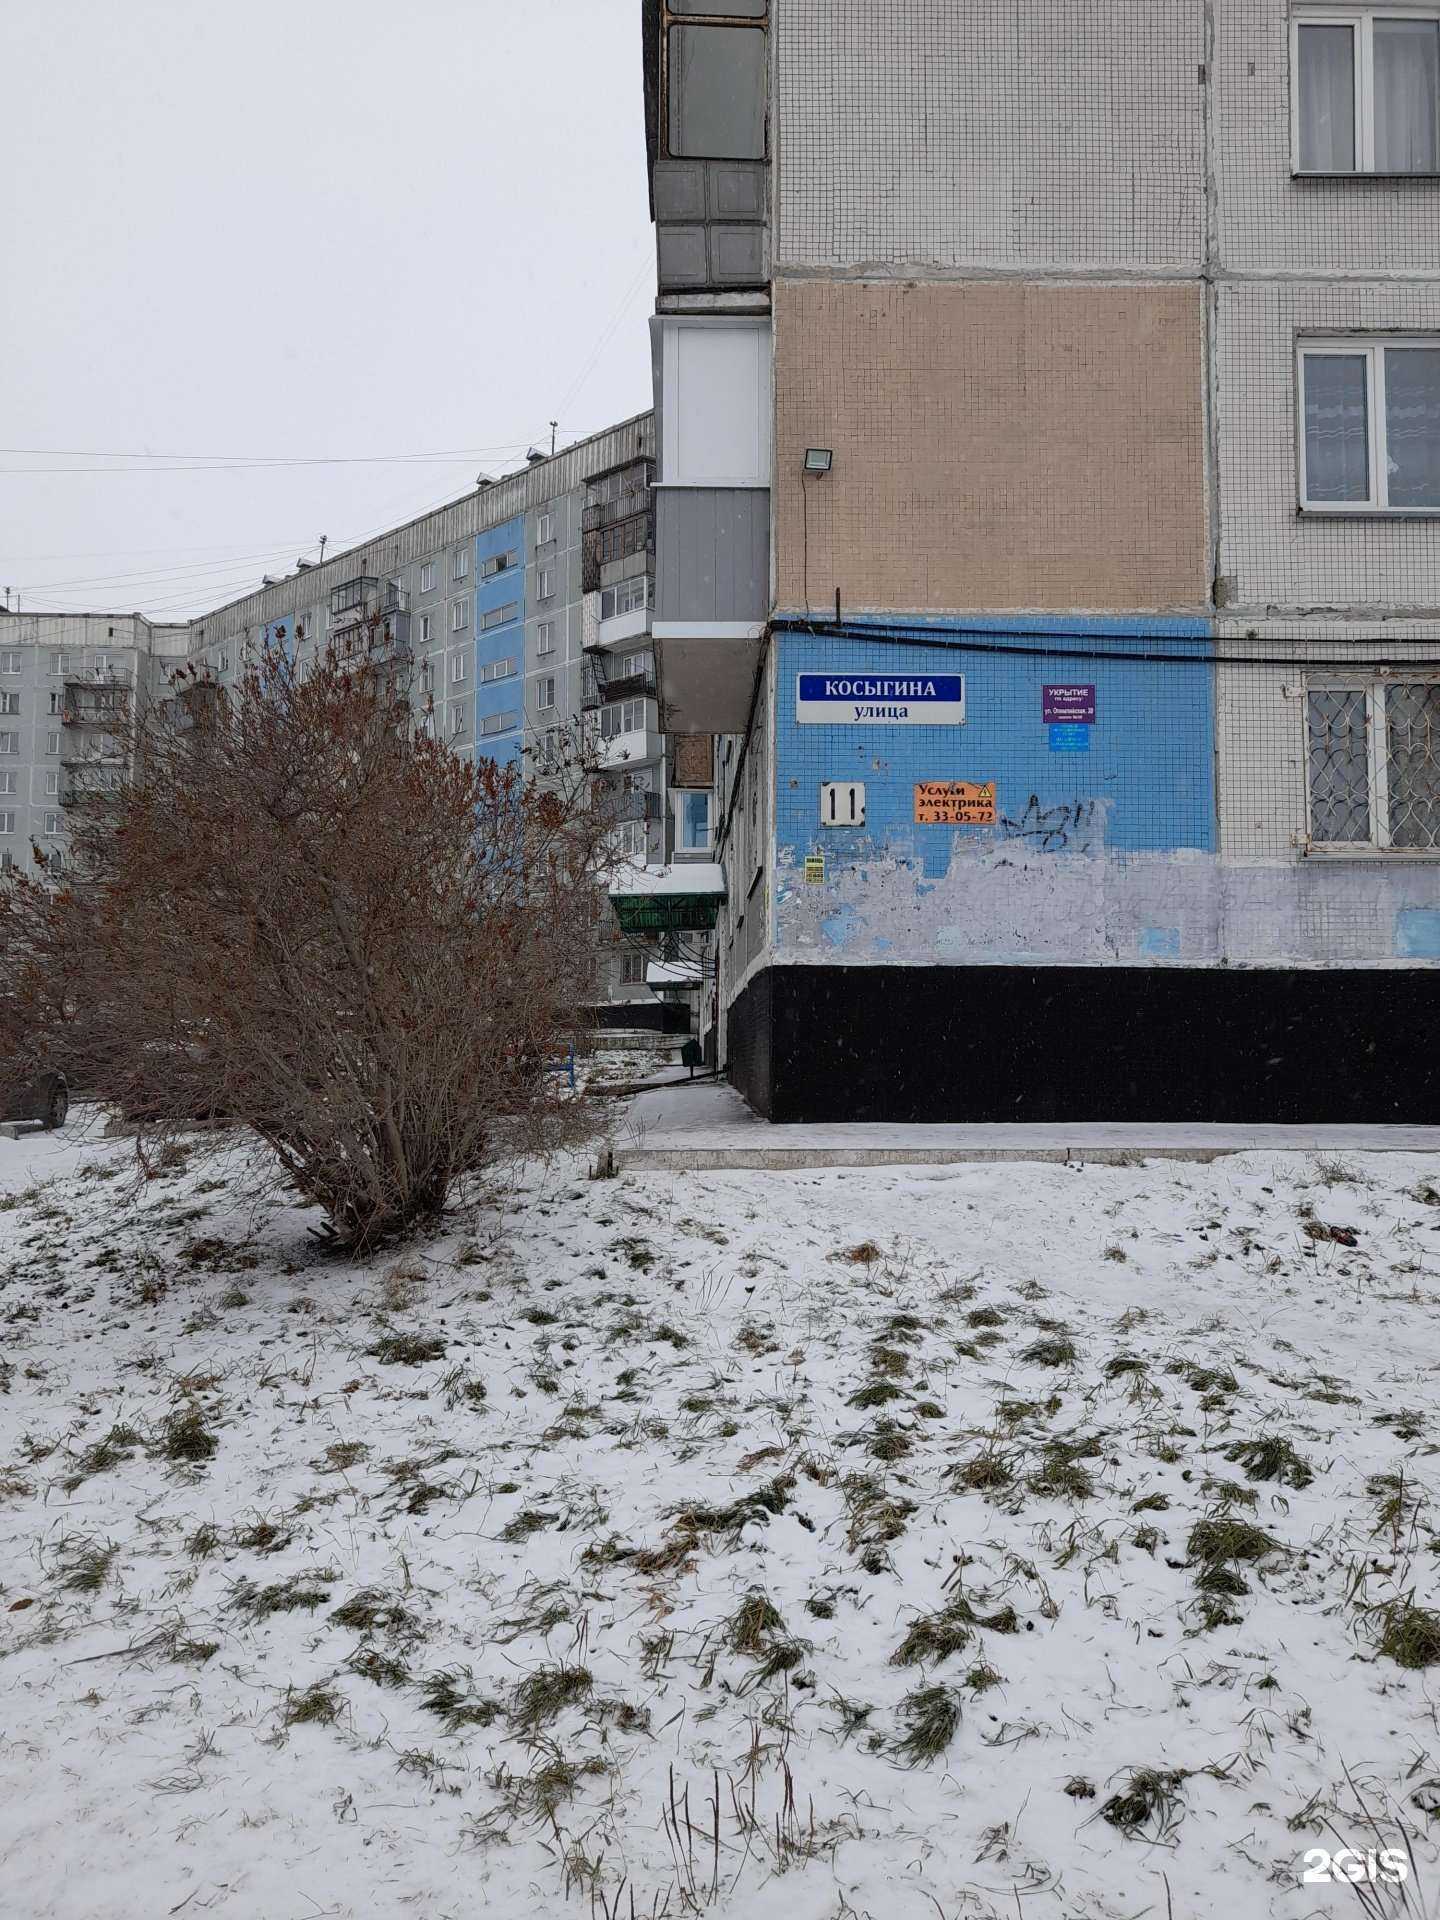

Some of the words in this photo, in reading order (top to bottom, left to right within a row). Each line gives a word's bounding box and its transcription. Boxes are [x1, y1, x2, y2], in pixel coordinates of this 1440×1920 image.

[825, 680, 937, 696] КОСЫГИНА
[1048, 688, 1089, 696] УКРЫТИЕ
[854, 706, 909, 722] улица
[918, 784, 966, 798] Услуги
[829, 788, 856, 820] 11
[918, 798, 993, 812] электрика
[918, 813, 929, 822] т.
[933, 811, 993, 822] 33-05-72
